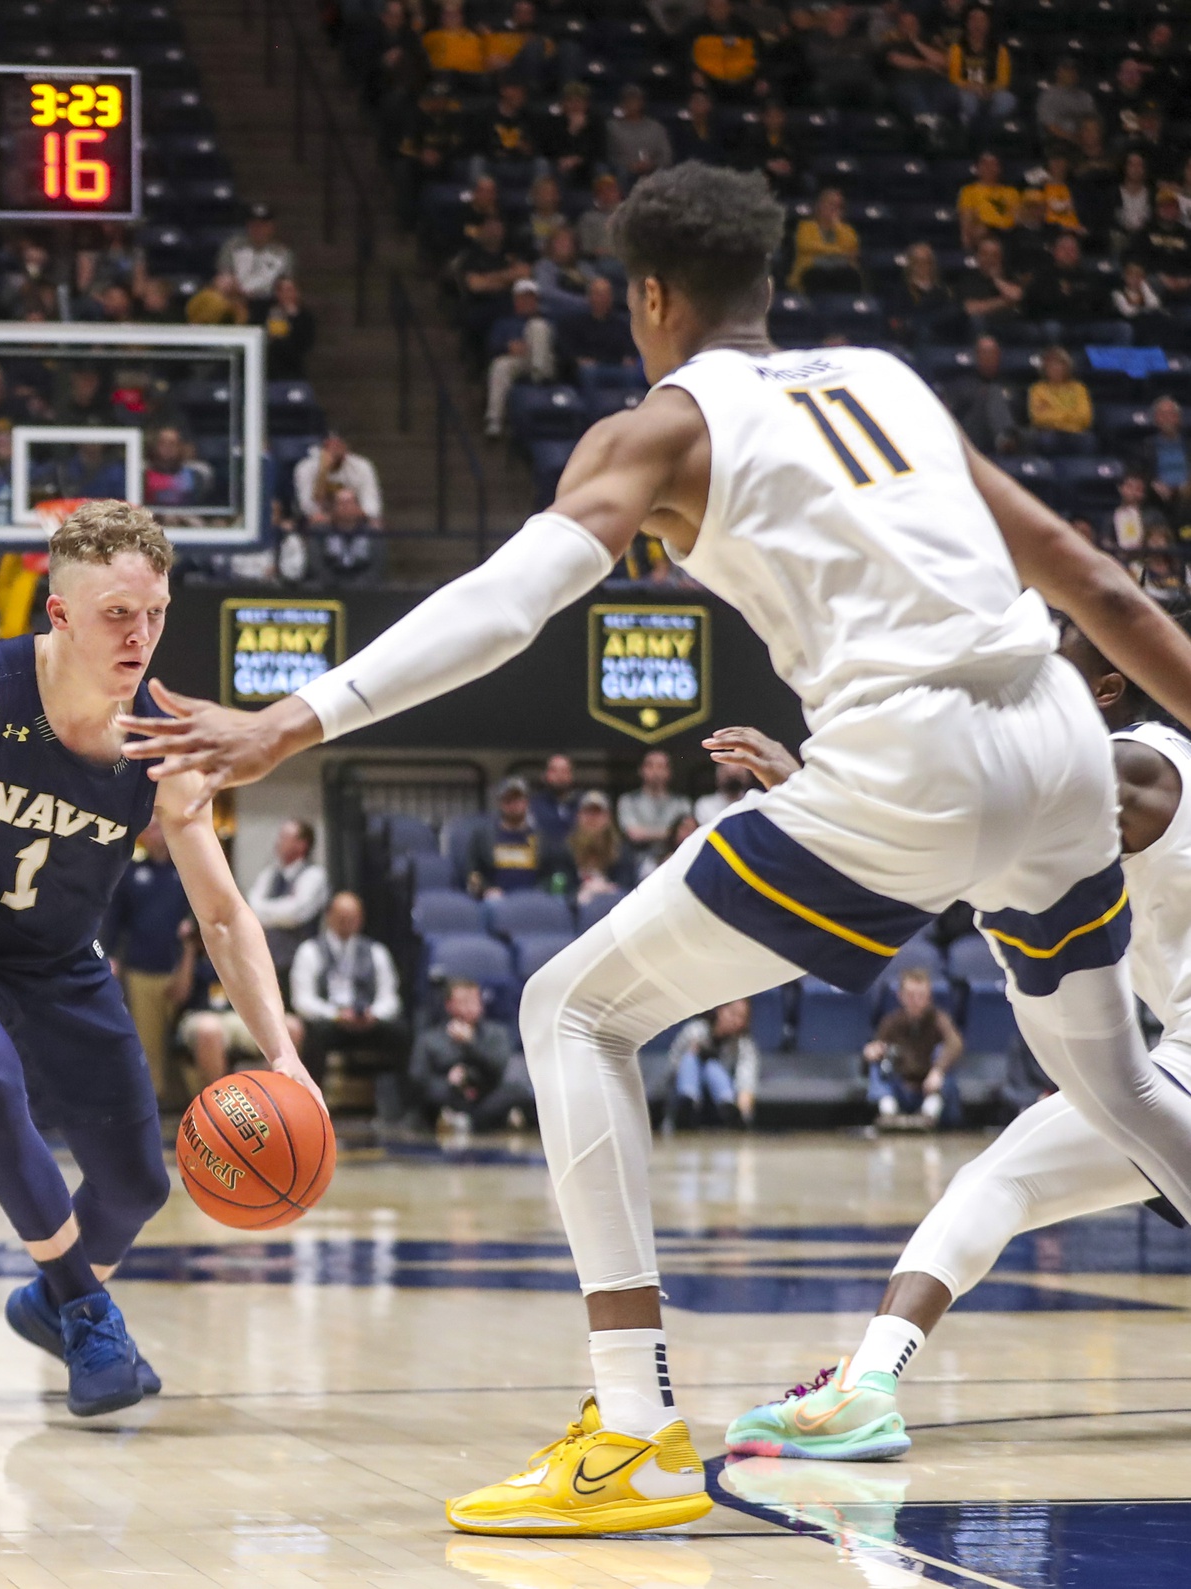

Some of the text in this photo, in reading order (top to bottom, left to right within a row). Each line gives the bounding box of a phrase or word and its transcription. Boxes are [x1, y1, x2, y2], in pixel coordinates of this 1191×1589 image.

[31, 84, 122, 127] 3:23
[44, 129, 110, 202] 16
[783, 385, 915, 488] 11
[236, 626, 328, 653] ARMY
[604, 632, 694, 658] ARMY
[601, 672, 698, 700] GUARD
[0, 837, 50, 911] 1
